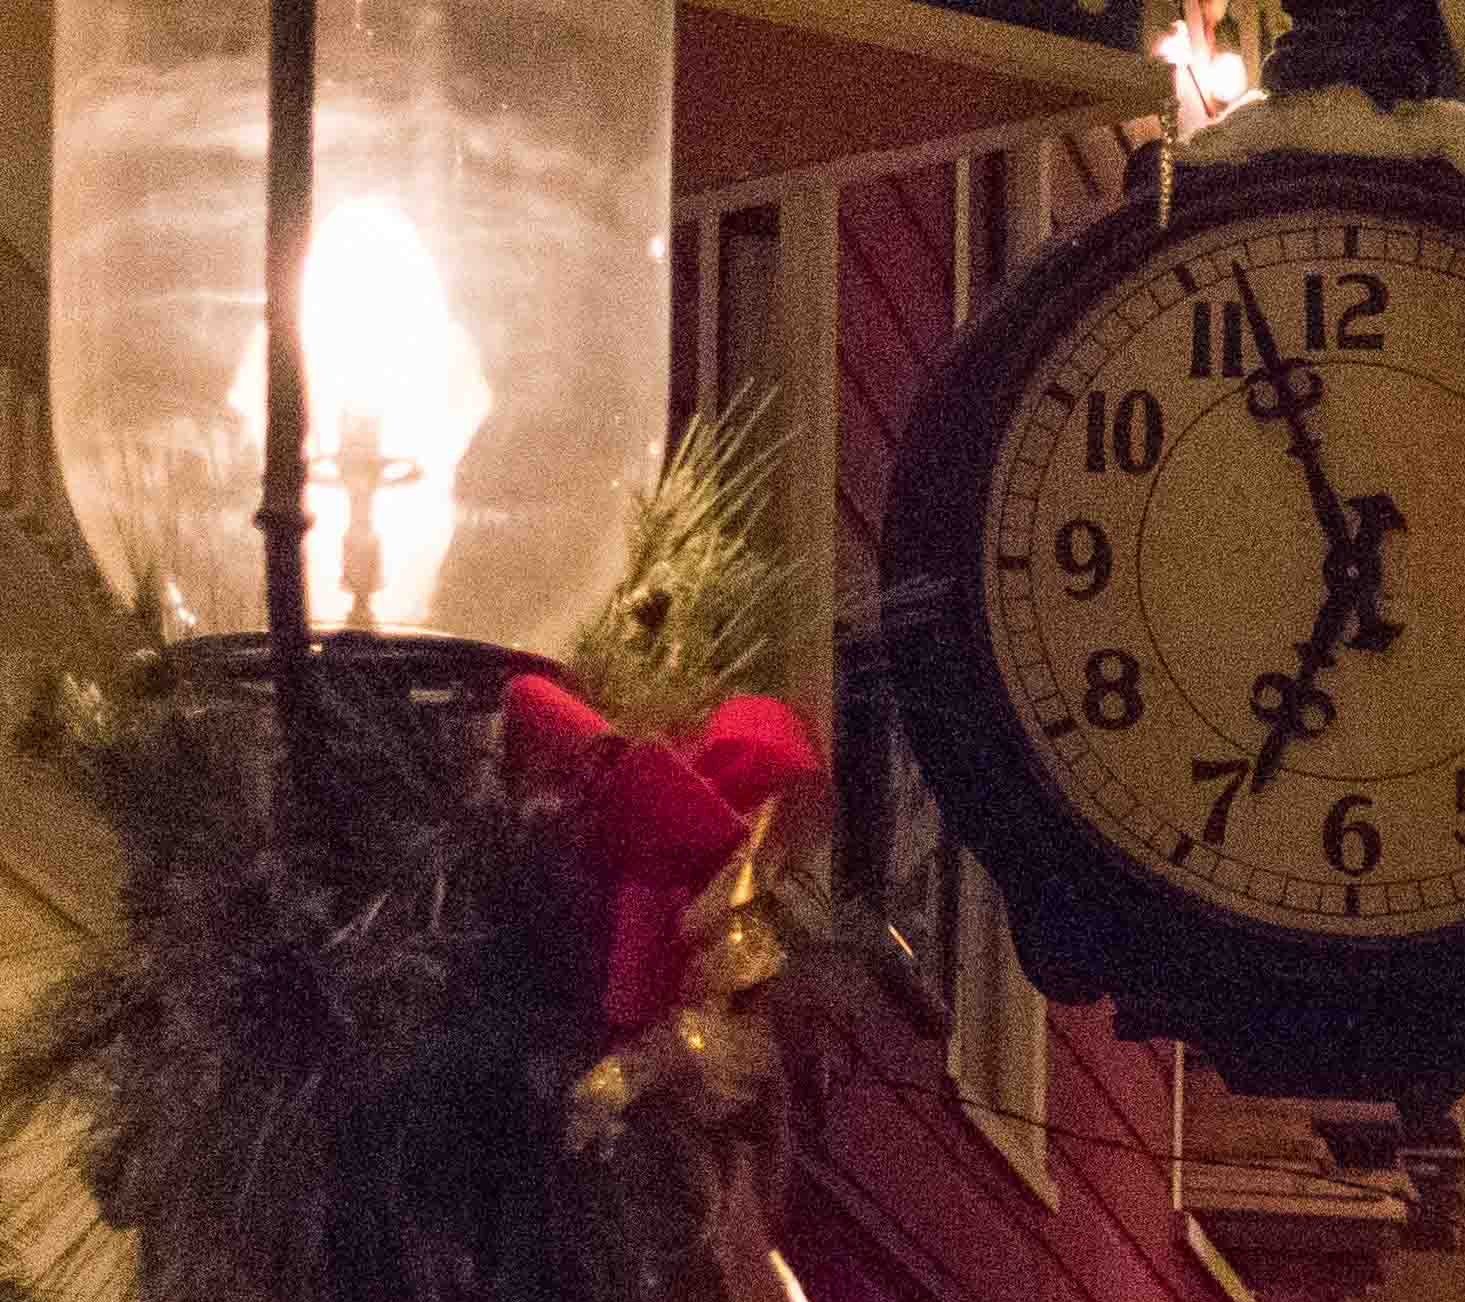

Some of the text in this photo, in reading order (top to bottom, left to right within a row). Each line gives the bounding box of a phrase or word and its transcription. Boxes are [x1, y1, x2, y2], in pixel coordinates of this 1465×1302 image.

[1190, 300, 1243, 378] 11
[1304, 273, 1389, 351] 12
[1086, 390, 1164, 472] 10
[1054, 519, 1111, 599] 9
[1084, 649, 1143, 730] 8
[1191, 759, 1250, 844] 7
[1322, 794, 1381, 876] 6
